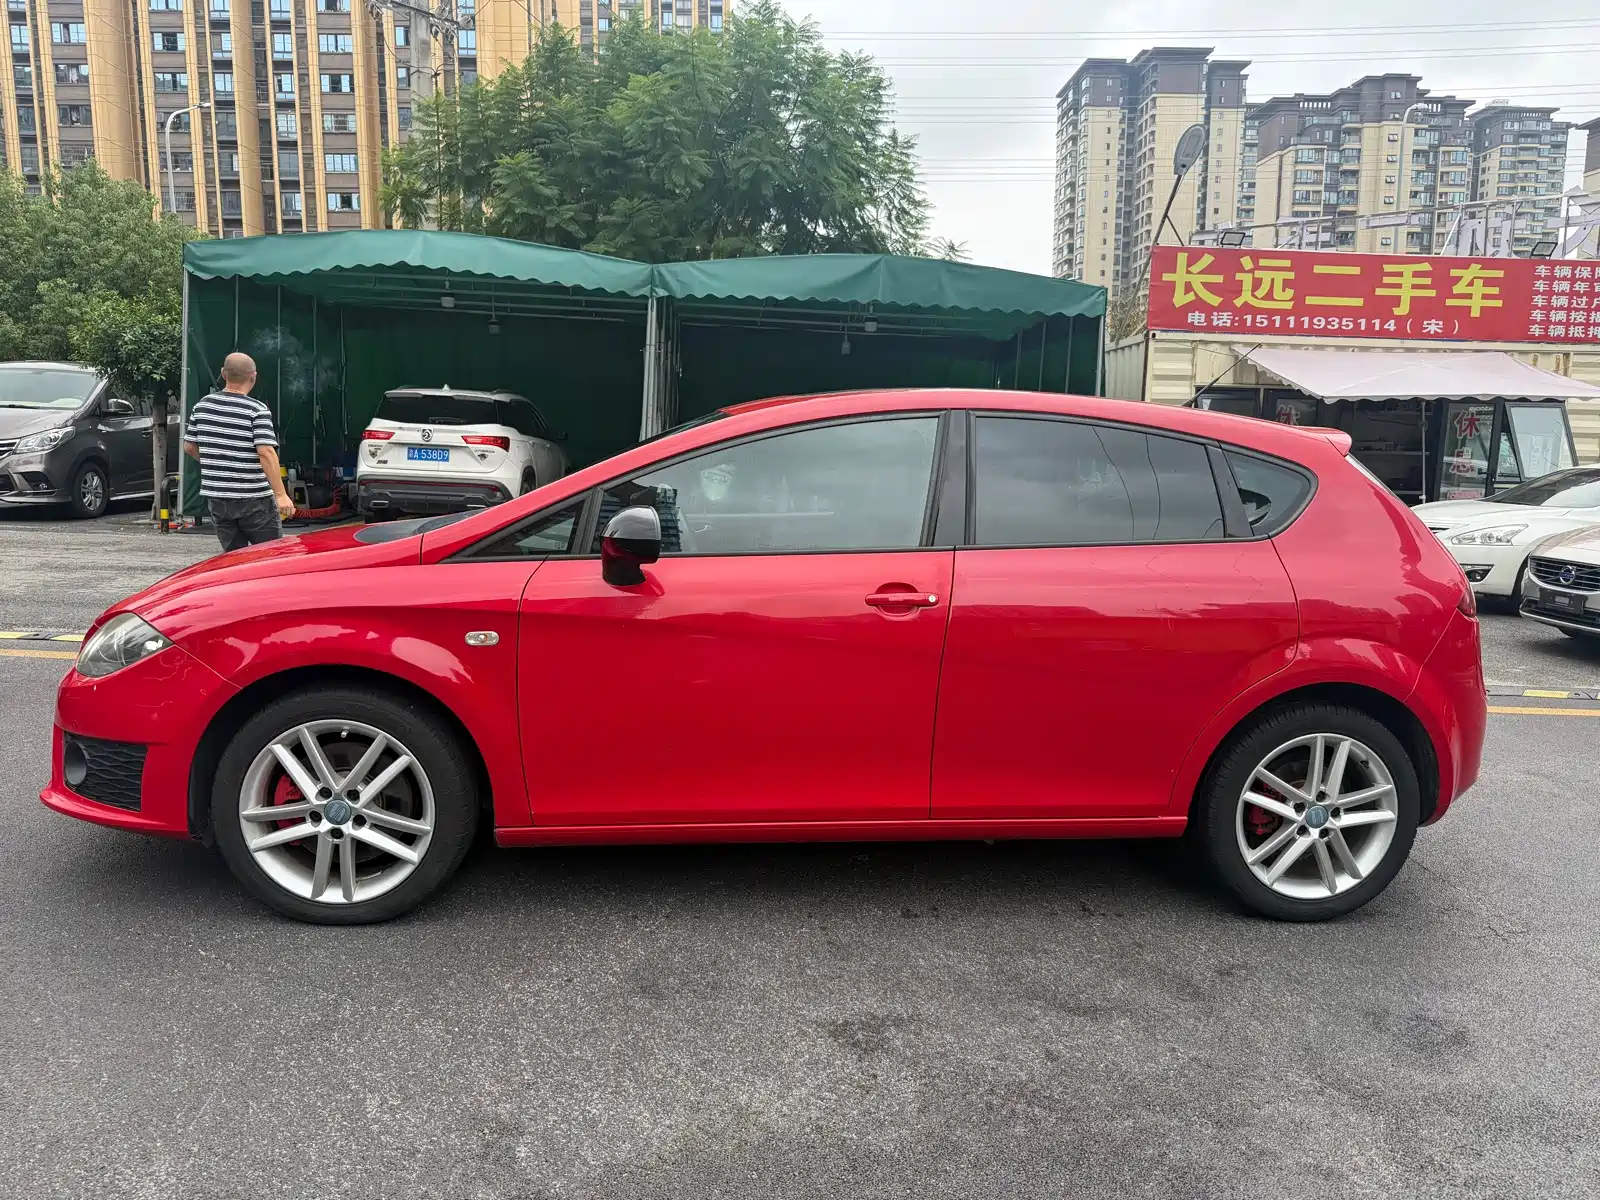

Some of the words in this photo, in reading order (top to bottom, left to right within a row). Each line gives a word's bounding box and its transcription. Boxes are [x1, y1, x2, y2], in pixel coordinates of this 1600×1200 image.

[1162, 252, 1504, 318] 长远二手车
